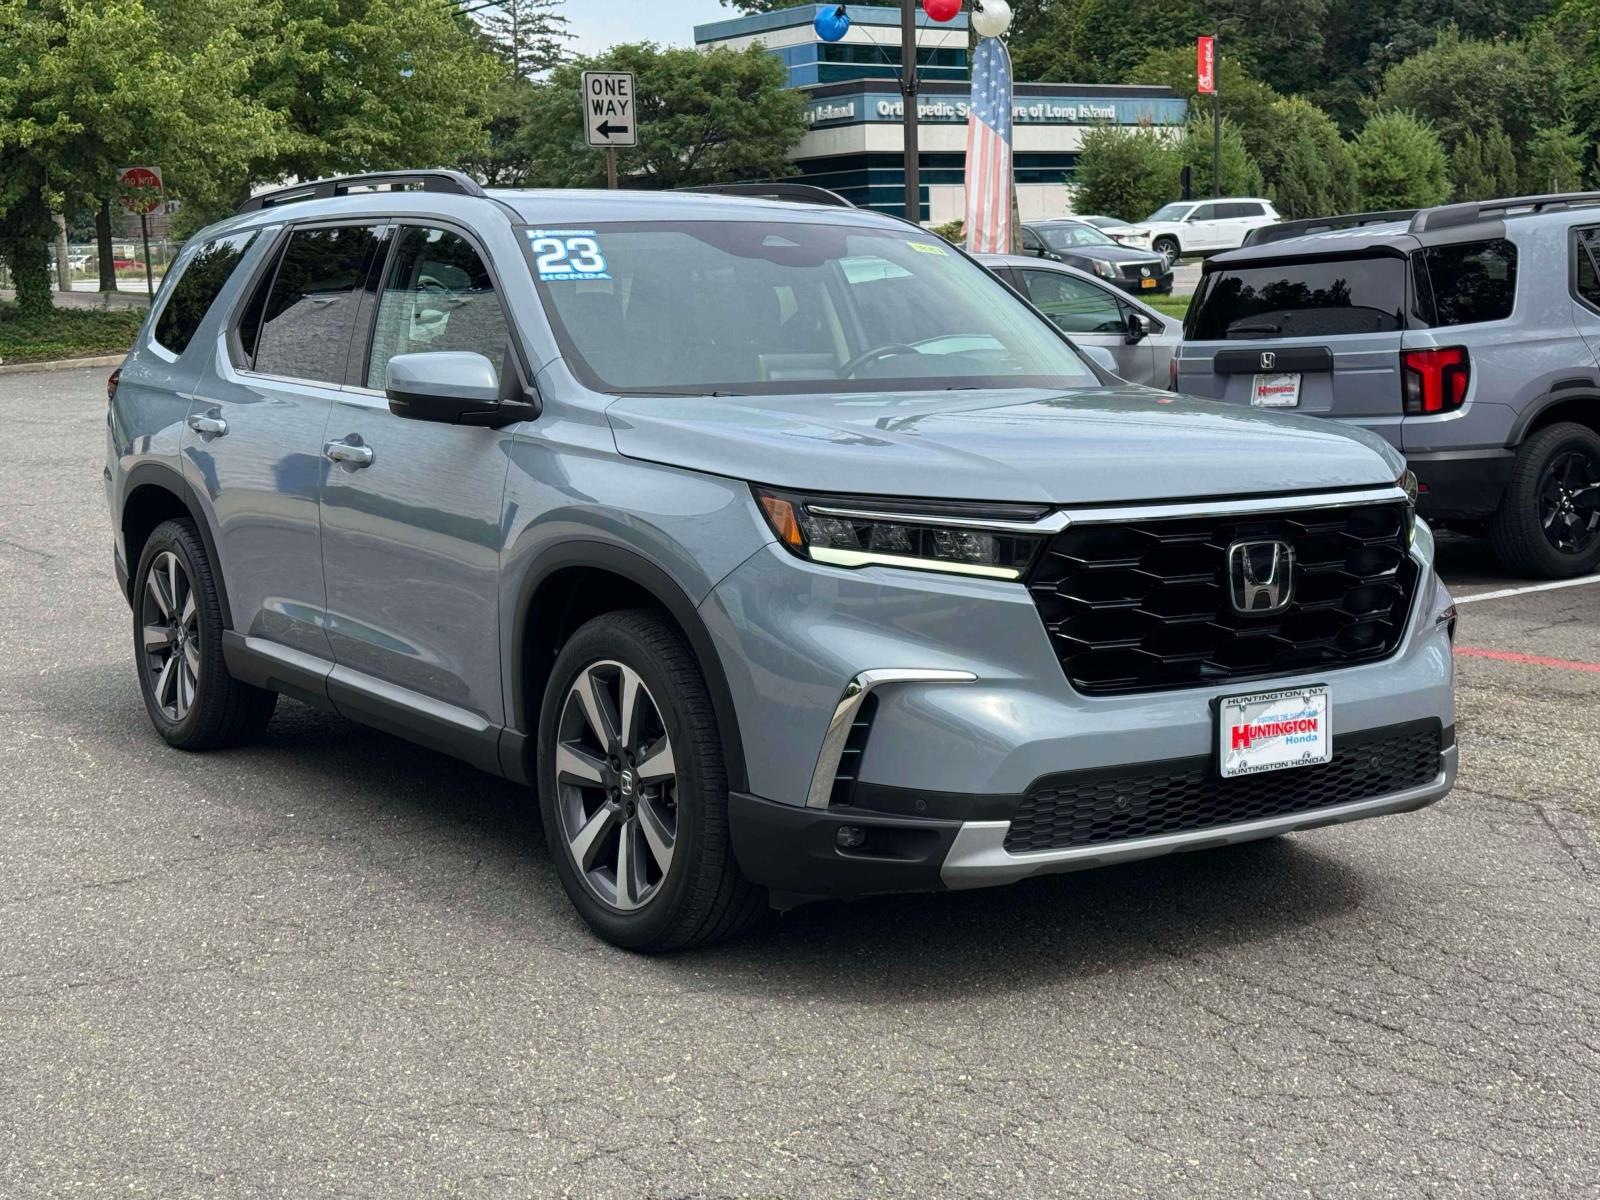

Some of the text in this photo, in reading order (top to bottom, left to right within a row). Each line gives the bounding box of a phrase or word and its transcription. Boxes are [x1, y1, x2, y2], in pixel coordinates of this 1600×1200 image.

[592, 78, 628, 96] ONE
[591, 99, 629, 116] WAY
[877, 101, 954, 118] Ortpedic
[1028, 104, 1044, 117] of
[1045, 104, 1077, 120] Long
[1078, 104, 1116, 118] Island
[532, 238, 608, 273] 23
[540, 273, 612, 281] HONDA
[1309, 687, 1325, 695] NY
[1232, 718, 1318, 750] HUNTINGTON
[1285, 734, 1318, 745] Honda
[1227, 756, 1326, 776] HUNTINGTON HONDA
